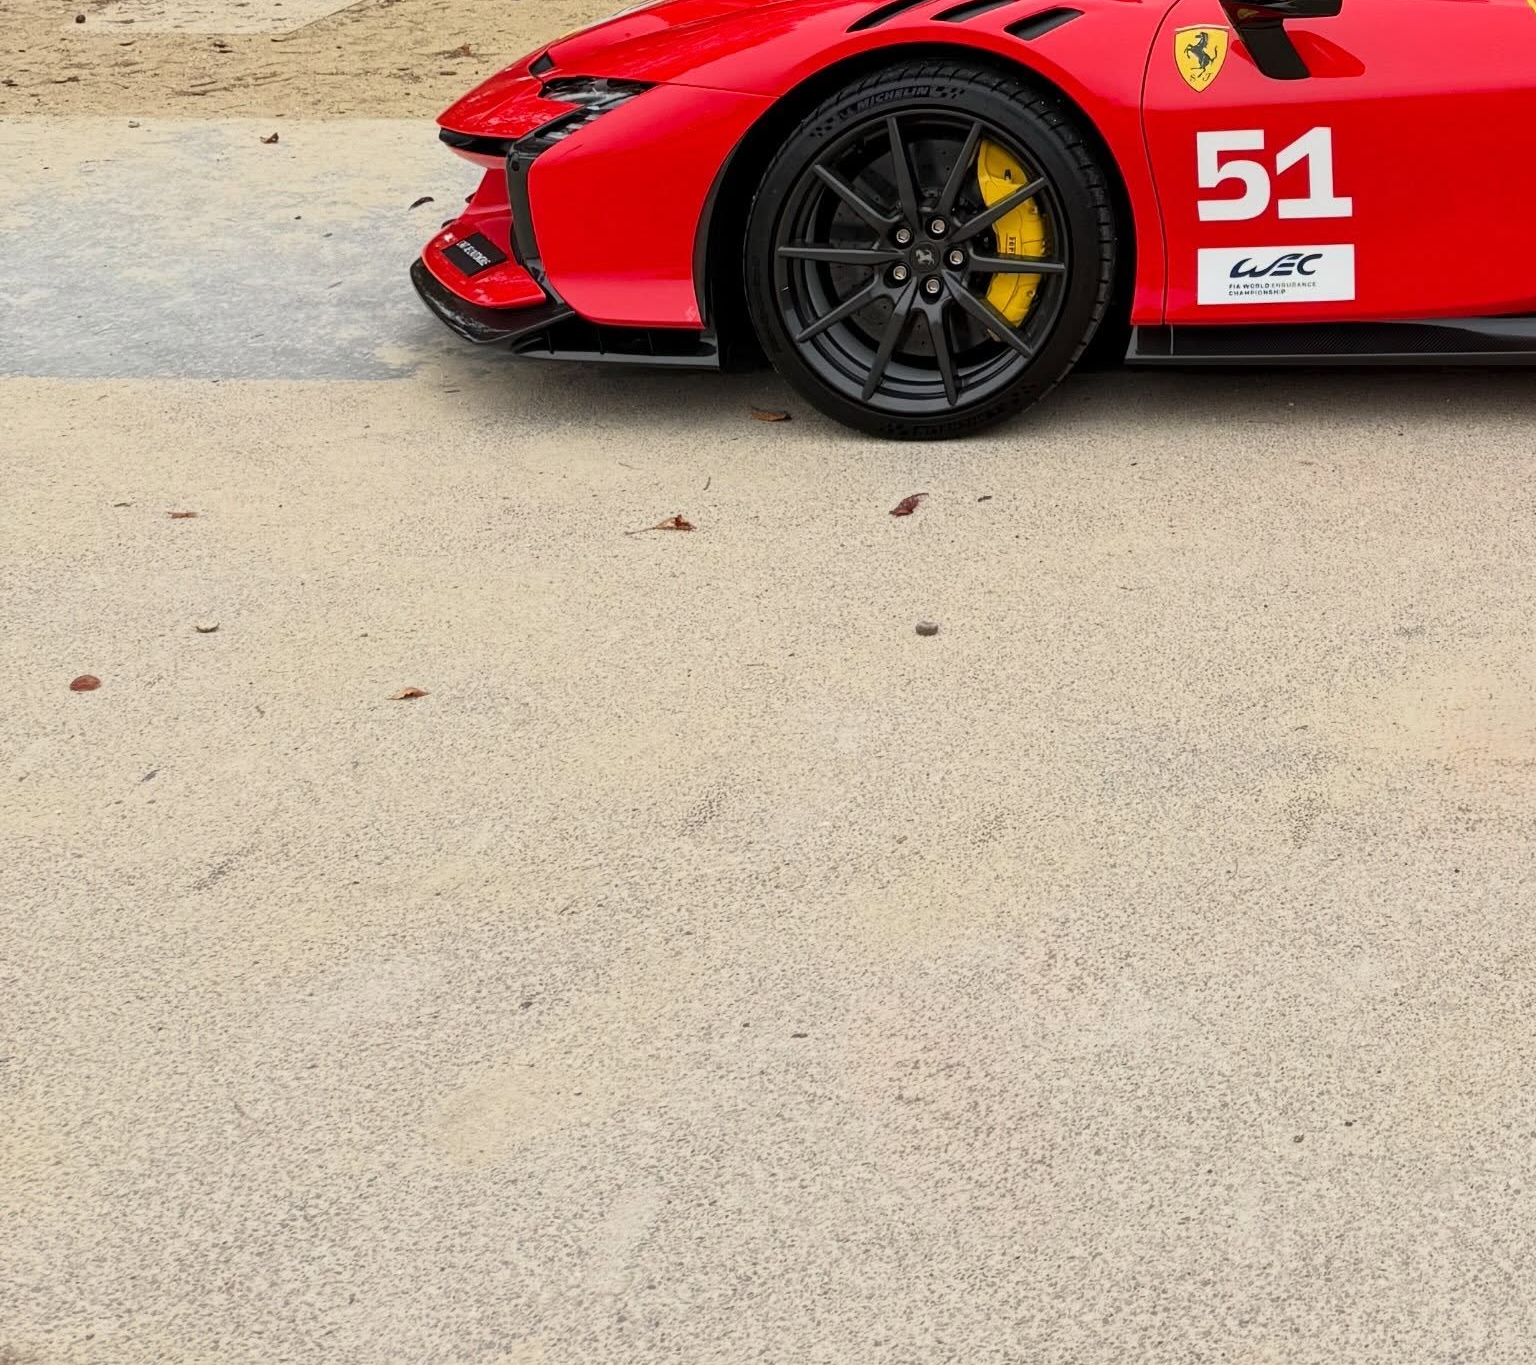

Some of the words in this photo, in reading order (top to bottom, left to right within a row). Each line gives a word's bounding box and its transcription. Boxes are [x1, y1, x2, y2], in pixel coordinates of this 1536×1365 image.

[856, 84, 930, 110] MICHELIN
[1196, 126, 1353, 222] 51
[1229, 252, 1324, 279] WEC
